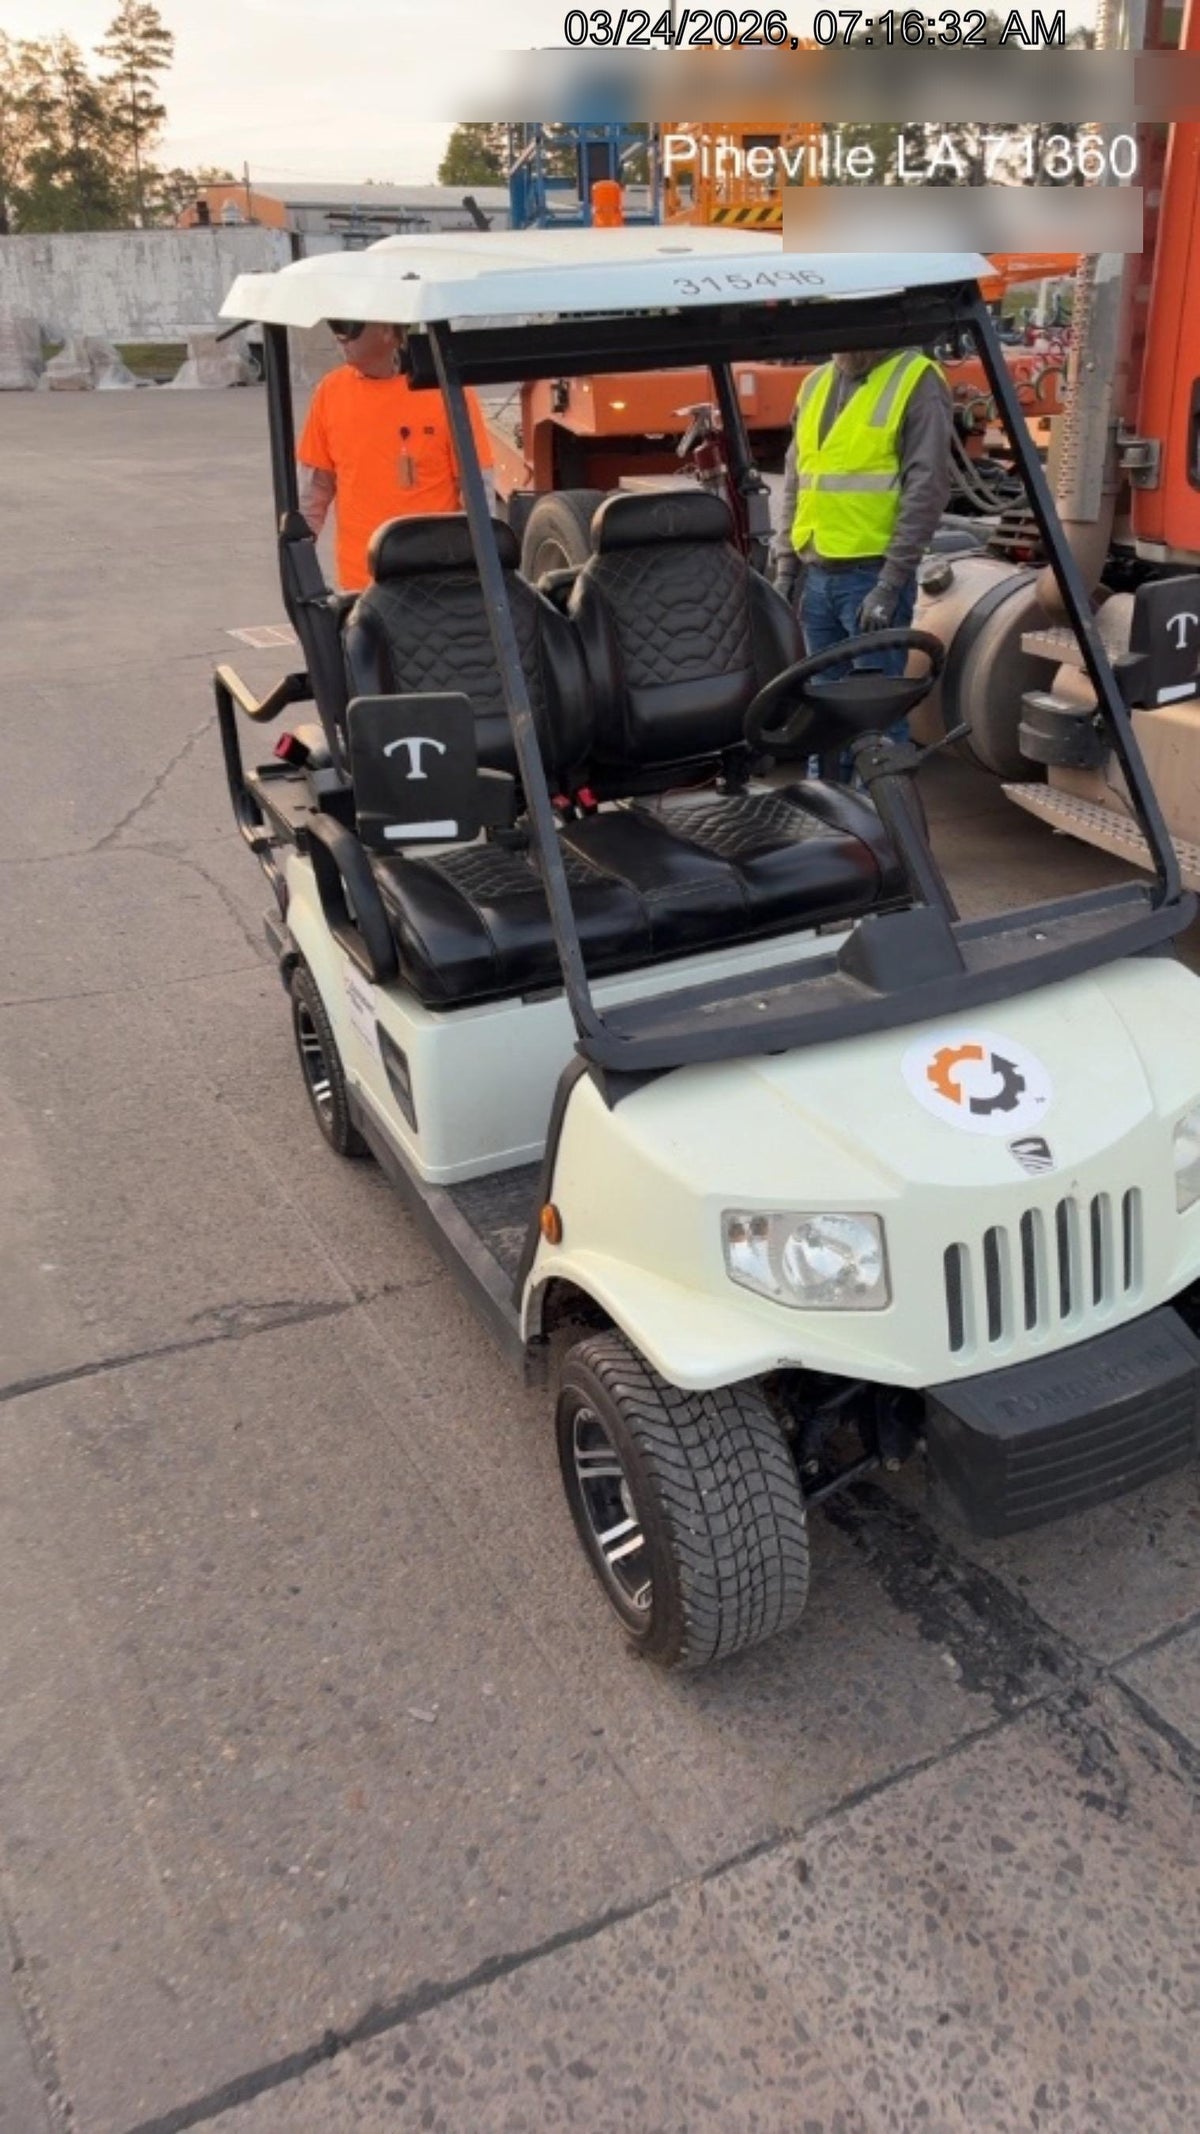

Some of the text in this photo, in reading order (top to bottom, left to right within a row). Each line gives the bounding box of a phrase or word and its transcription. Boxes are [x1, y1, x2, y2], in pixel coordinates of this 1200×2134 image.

[673, 269, 825, 296] 315496
[1166, 611, 1199, 650] T
[383, 736, 447, 779] T
